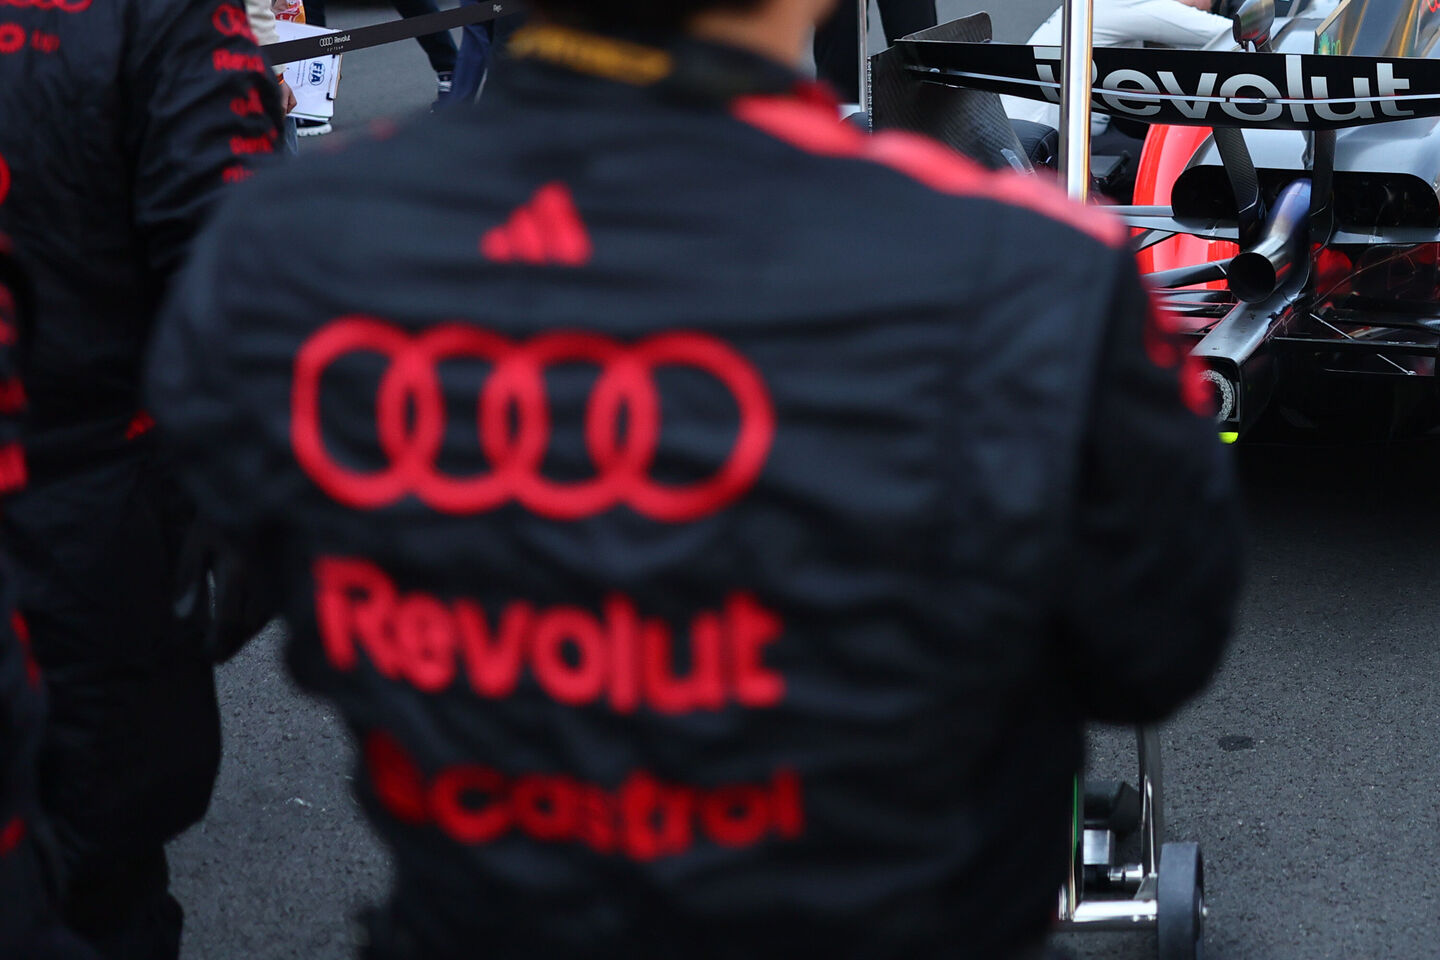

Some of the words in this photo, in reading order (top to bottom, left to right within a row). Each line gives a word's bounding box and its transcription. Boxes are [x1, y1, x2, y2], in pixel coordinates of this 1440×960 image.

[311, 62, 323, 83] FIA
[1033, 46, 1414, 123] Revolut
[314, 555, 786, 715] Revolut
